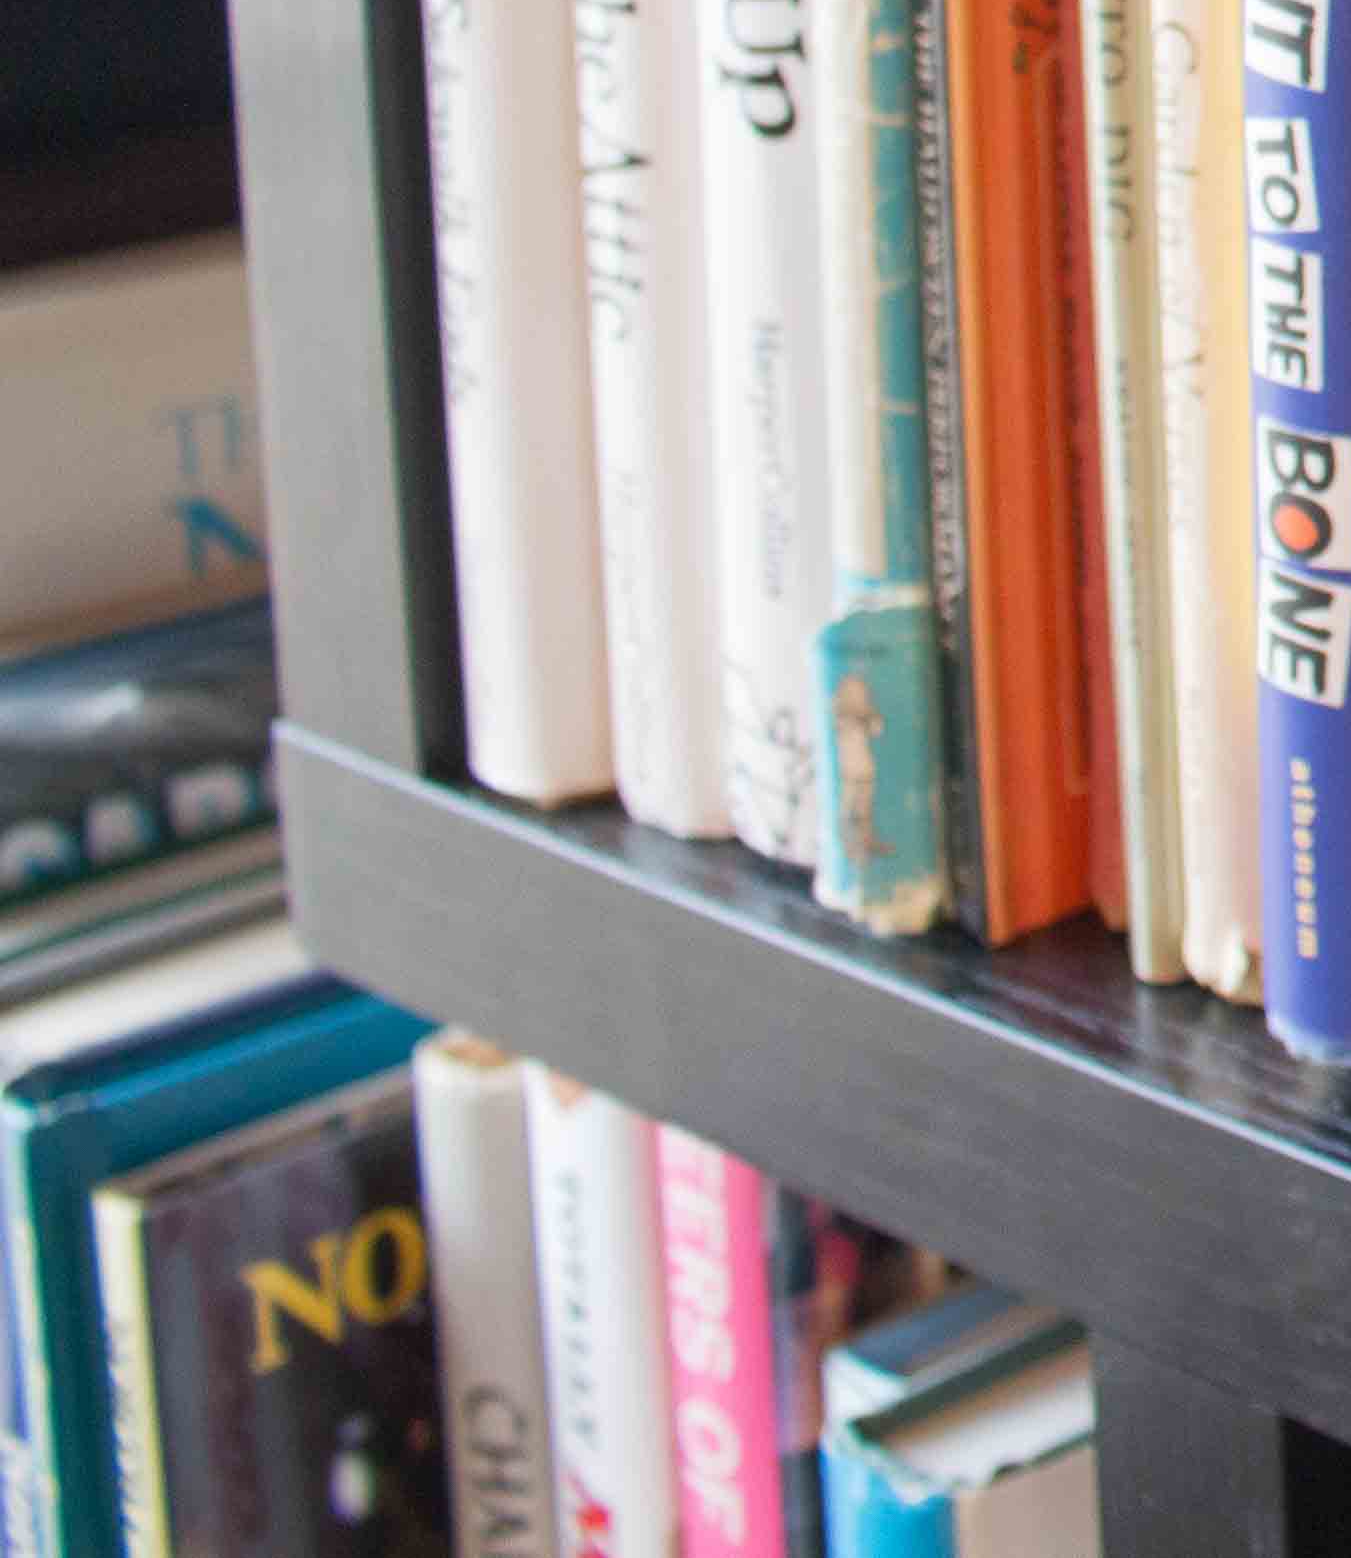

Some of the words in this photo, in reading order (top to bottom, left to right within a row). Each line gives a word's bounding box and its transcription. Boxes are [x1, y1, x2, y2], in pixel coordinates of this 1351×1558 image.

[1261, 123, 1302, 225] TO
[1264, 241, 1307, 383] THE
[1266, 425, 1337, 698] BONE
